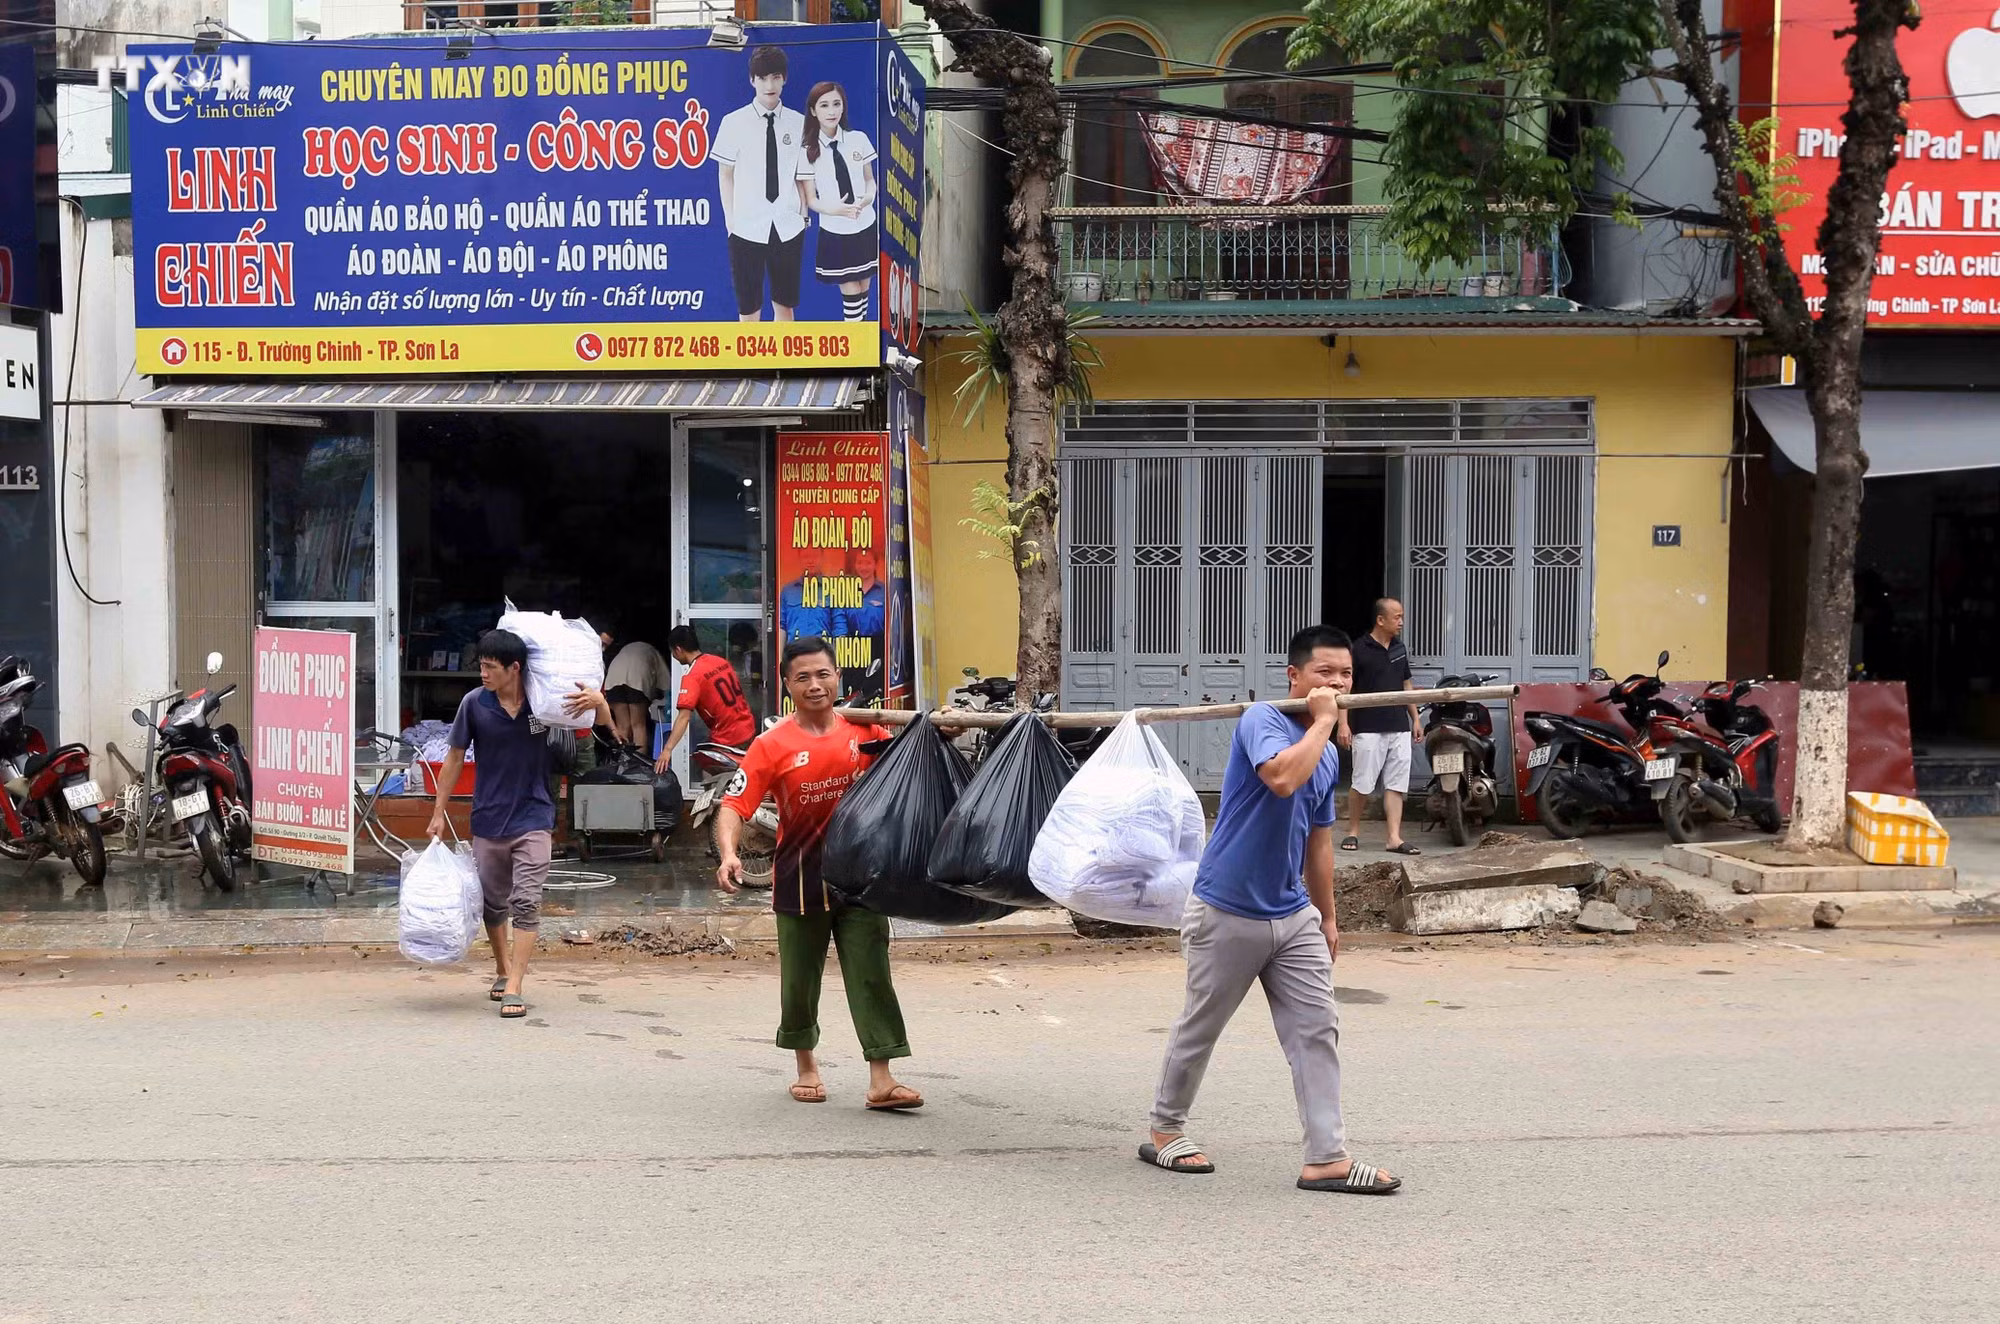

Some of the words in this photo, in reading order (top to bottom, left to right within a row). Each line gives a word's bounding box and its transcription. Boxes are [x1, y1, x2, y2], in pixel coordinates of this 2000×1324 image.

[321, 62, 422, 102] CHUYÊN
[431, 67, 485, 99] MAY
[493, 65, 527, 97] ĐO
[536, 52, 608, 96] ĐỒNG
[617, 60, 688, 100] PHỤC
[196, 104, 229, 118] Linh
[232, 102, 275, 118] Chiến
[258, 84, 295, 112] may
[303, 126, 389, 190] HỌC
[397, 123, 497, 176] SINH
[527, 106, 645, 172] CÔNG
[653, 98, 709, 170] SỞ
[1797, 128, 1848, 158] iPh
[1904, 130, 1964, 160] iPad
[166, 146, 277, 213] LINH
[304, 197, 363, 236] QUẦN
[369, 200, 397, 231] ÁO
[405, 196, 448, 231] BẢO
[454, 198, 484, 235] HỘ
[505, 192, 565, 231] QUẦN
[572, 195, 600, 227] ÁO
[607, 188, 648, 226] THỂ
[654, 198, 710, 226] THAO
[155, 218, 295, 307] CHIẾN
[347, 244, 376, 277] ÁO
[382, 243, 441, 275] ĐOÀN
[463, 241, 491, 274] ÁO
[498, 241, 535, 278] ĐỘI
[556, 239, 586, 272] ÁO
[592, 238, 668, 271] PHÔNG
[1915, 250, 1957, 276] SỬA
[314, 290, 361, 313] Nhận
[367, 290, 398, 313] đặt
[403, 287, 427, 310] số
[429, 288, 479, 314] lượng
[485, 288, 513, 308] lớn
[530, 288, 559, 311] Uy
[562, 287, 586, 307] tín
[603, 284, 646, 307] Chất
[650, 286, 703, 311] lượng
[1891, 297, 1930, 313] Chinh
[1941, 299, 1959, 313] TP
[1962, 297, 1987, 313] Sơn
[193, 342, 222, 362] 115
[237, 341, 254, 362] Đ.
[257, 340, 312, 364] Trường
[316, 340, 362, 361] Chinh
[378, 341, 400, 361] TP.
[405, 340, 436, 361] Sơn
[440, 340, 460, 360] La
[607, 337, 648, 358] 0977
[654, 337, 684, 357] 872
[689, 337, 720, 357] 468
[736, 336, 778, 357] 0344
[783, 336, 813, 357] 095
[818, 335, 850, 356] 803
[786, 440, 827, 457] Linh
[833, 438, 879, 457] Chiến
[782, 463, 800, 482] 0344
[801, 463, 814, 482] 095
[815, 463, 830, 482] 803
[836, 463, 854, 482] 0977
[855, 463, 869, 481] 872
[870, 463, 883, 482] 468
[792, 487, 830, 504] CHUYÊN
[832, 488, 859, 504] CUNG
[860, 483, 880, 504] CẤP
[792, 511, 808, 549] ÁO
[812, 510, 849, 552] ĐOÀN,
[851, 512, 872, 555] ĐỘI
[1657, 529, 1676, 542] 117
[802, 571, 819, 609] ÁO
[821, 571, 864, 609] PHÔNG
[835, 630, 872, 669] NHÓM
[259, 636, 300, 696] ĐỒNG
[304, 652, 345, 708] PHỤC
[258, 726, 292, 771] LINH
[296, 718, 343, 776] CHIẾN
[277, 782, 323, 800] CHUYÊN
[799, 789, 844, 805] Chartere
[801, 774, 849, 793] Standard
[255, 800, 275, 821] BÁN
[276, 801, 304, 825] BUÔN
[312, 803, 333, 826] BÁN
[335, 804, 346, 829] LẺ
[257, 846, 278, 860] ĐT:
[281, 857, 344, 870] 0977.872.468
